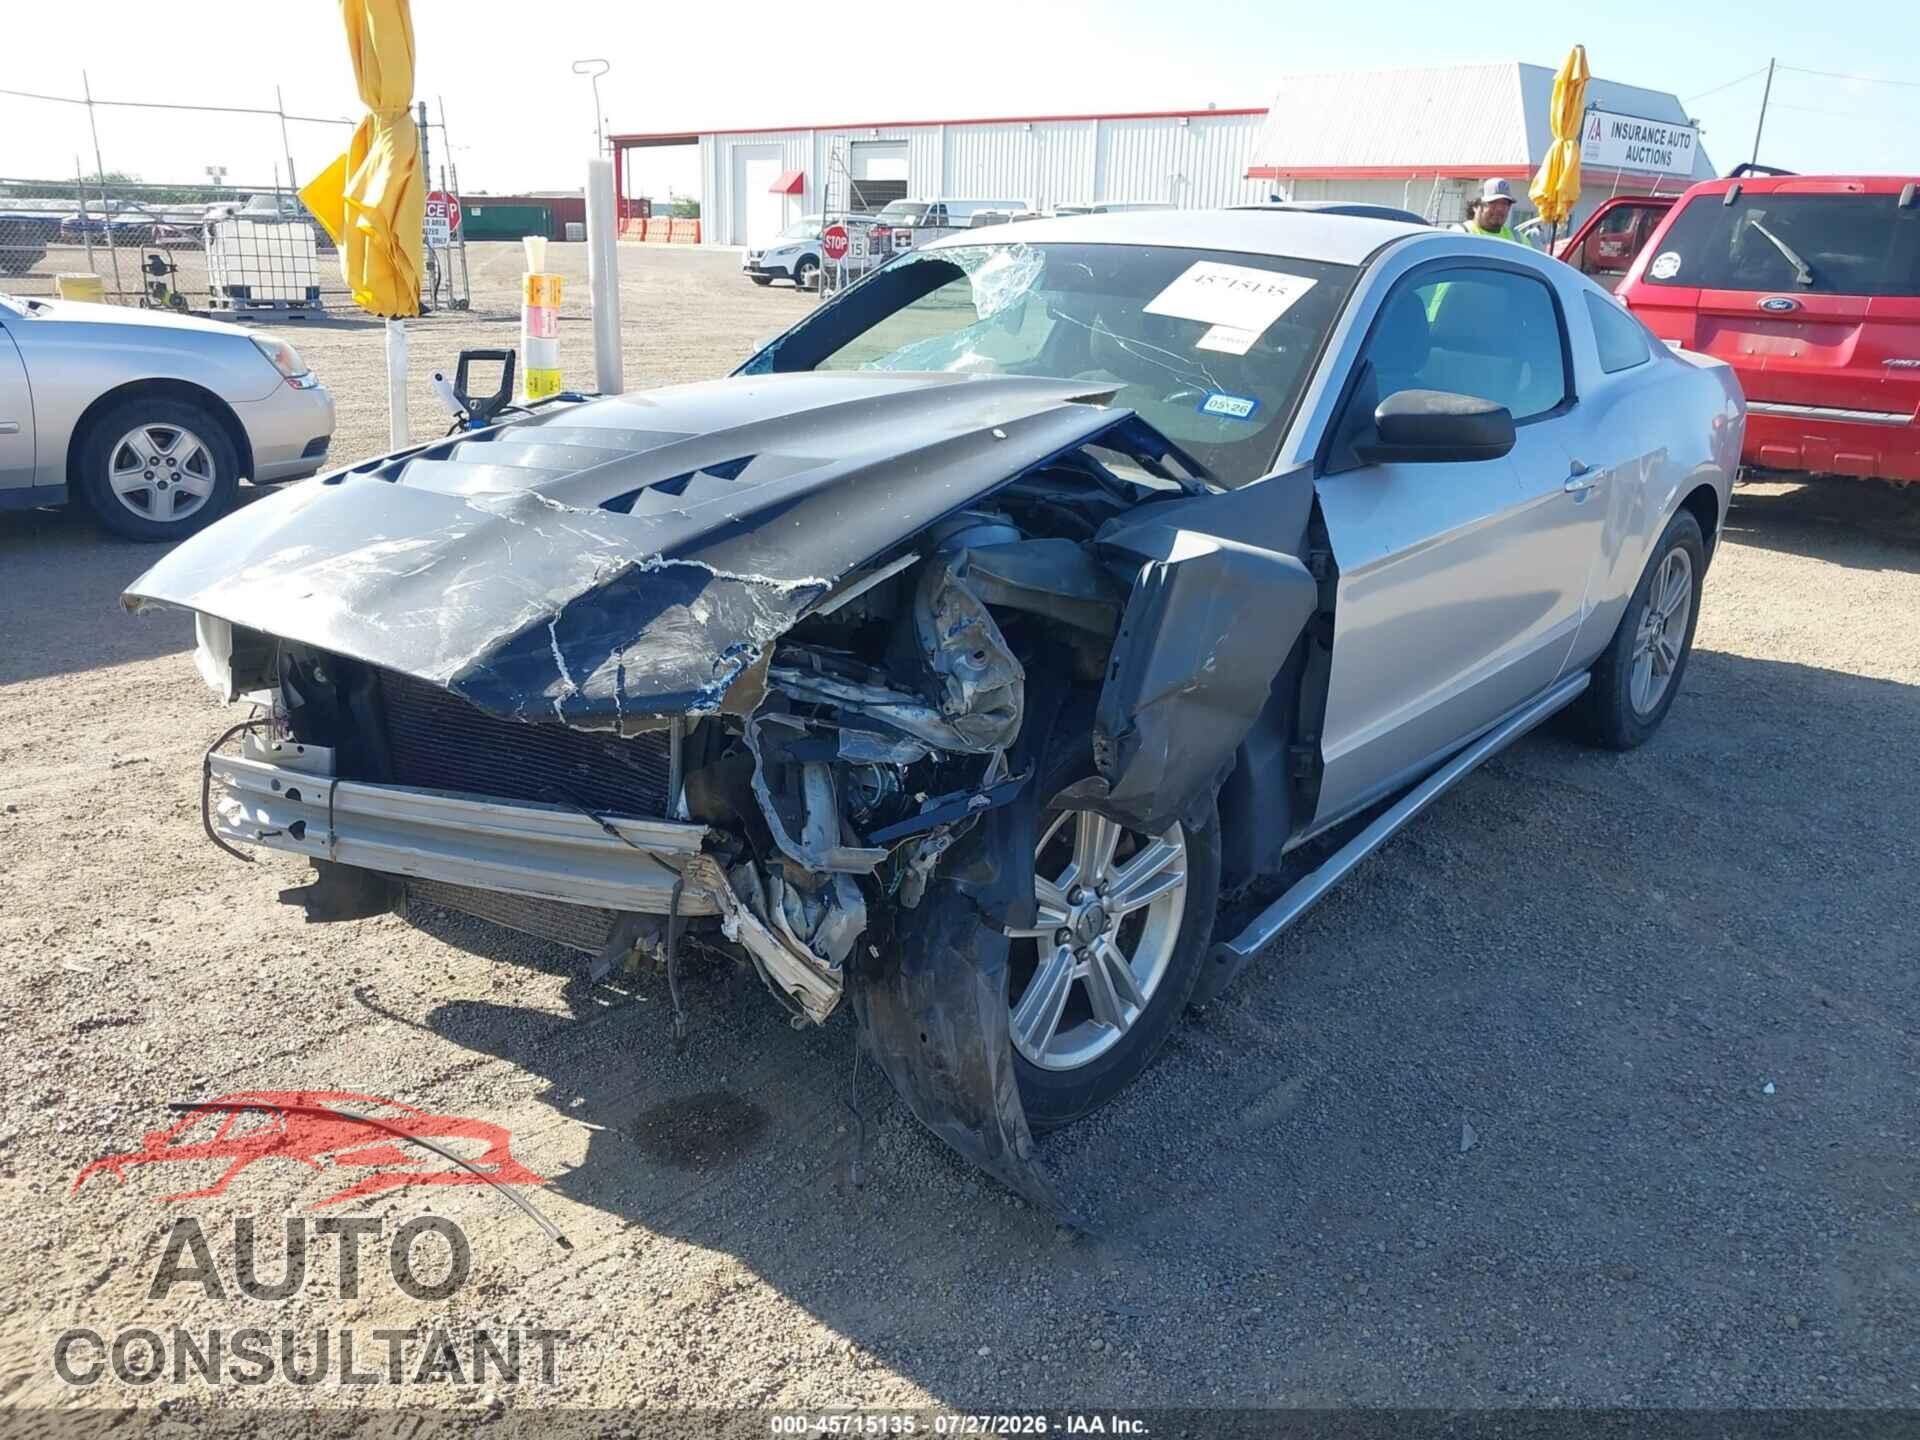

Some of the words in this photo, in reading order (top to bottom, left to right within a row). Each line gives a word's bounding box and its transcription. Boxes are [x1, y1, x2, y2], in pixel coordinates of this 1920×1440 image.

[1611, 121, 1666, 146] INSURANCE
[1667, 130, 1691, 149] AUTO
[1625, 145, 1672, 167] AUCTIONS
[825, 235, 848, 250] STOP
[852, 242, 863, 256] 15
